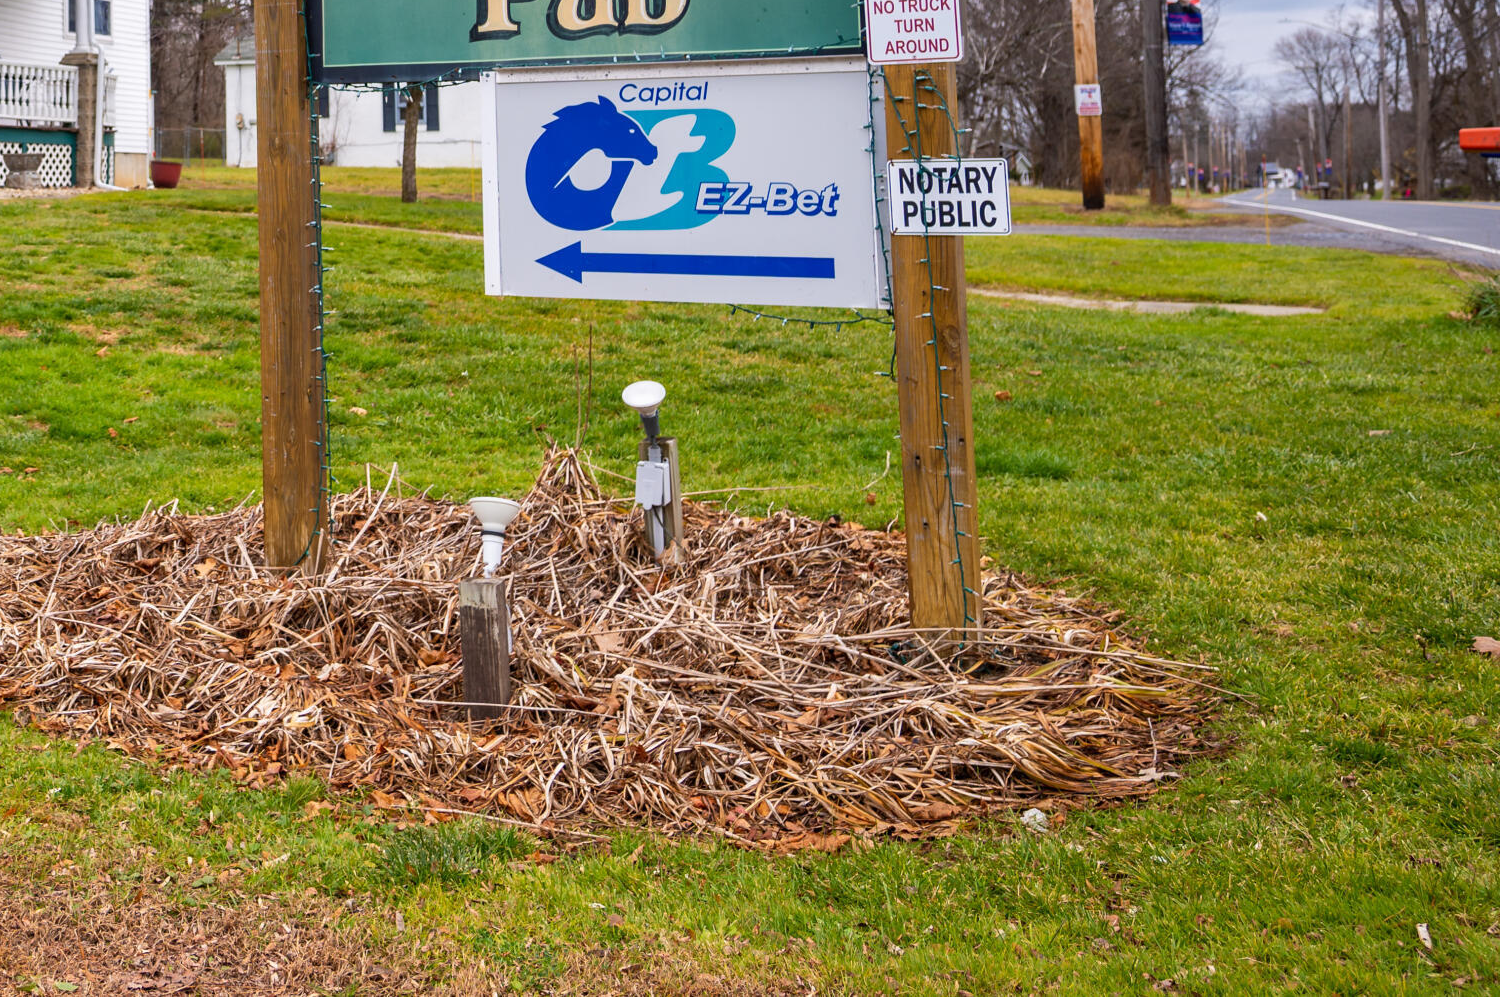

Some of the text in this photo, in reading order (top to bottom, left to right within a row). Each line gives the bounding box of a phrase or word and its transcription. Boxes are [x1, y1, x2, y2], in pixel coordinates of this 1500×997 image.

[873, 0, 895, 14] NO
[894, 18, 935, 33] TURN
[885, 38, 949, 55] AROUND
[619, 81, 708, 105] Capital
[899, 167, 997, 194] NOTARY
[695, 182, 840, 216] EZ-Bet
[903, 200, 997, 227] PUBLIC
